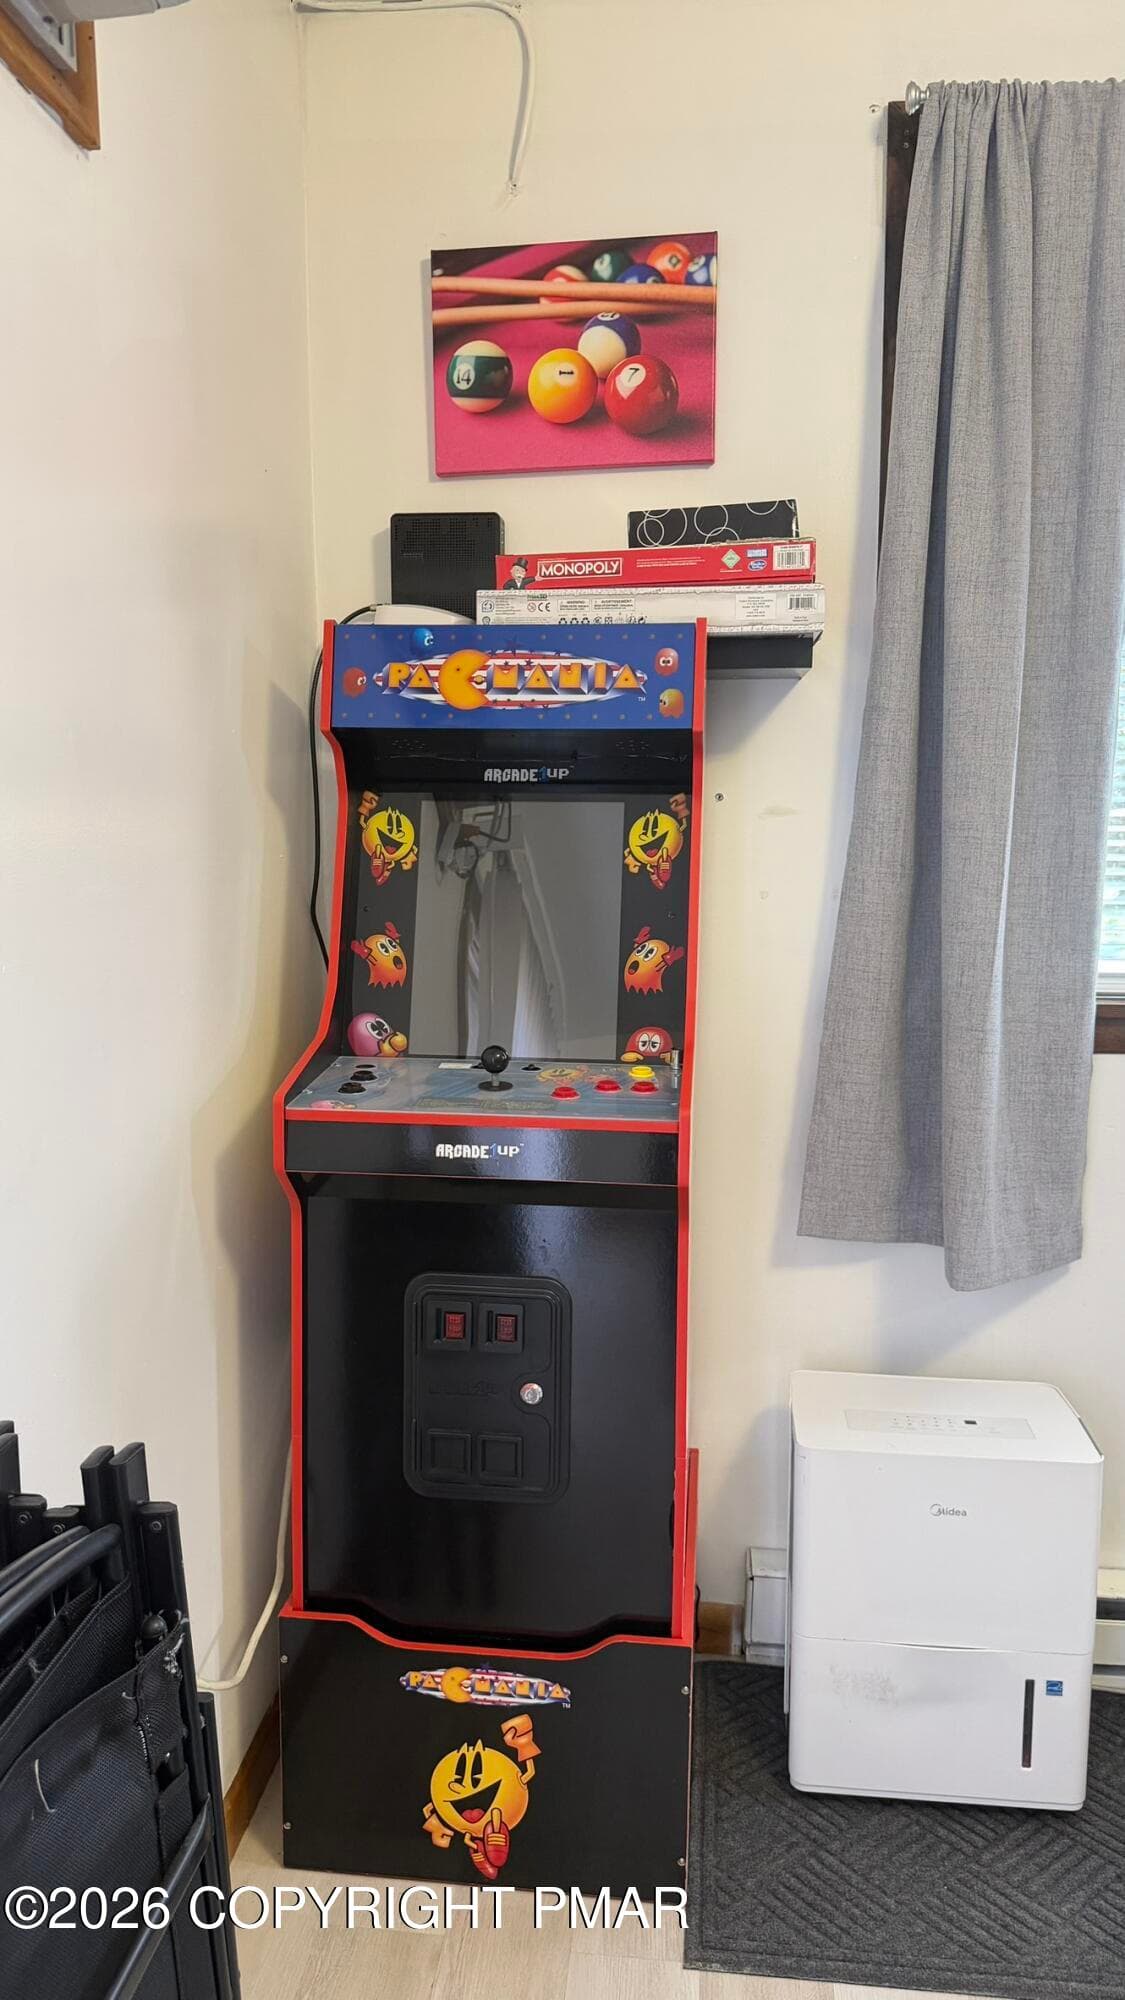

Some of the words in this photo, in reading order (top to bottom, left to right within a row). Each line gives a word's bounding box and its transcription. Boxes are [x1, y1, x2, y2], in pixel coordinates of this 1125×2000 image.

[456, 368, 472, 386] 14
[628, 367, 641, 382] 7
[541, 561, 620, 577] MONOPOLY
[930, 1503, 967, 1517] Midea
